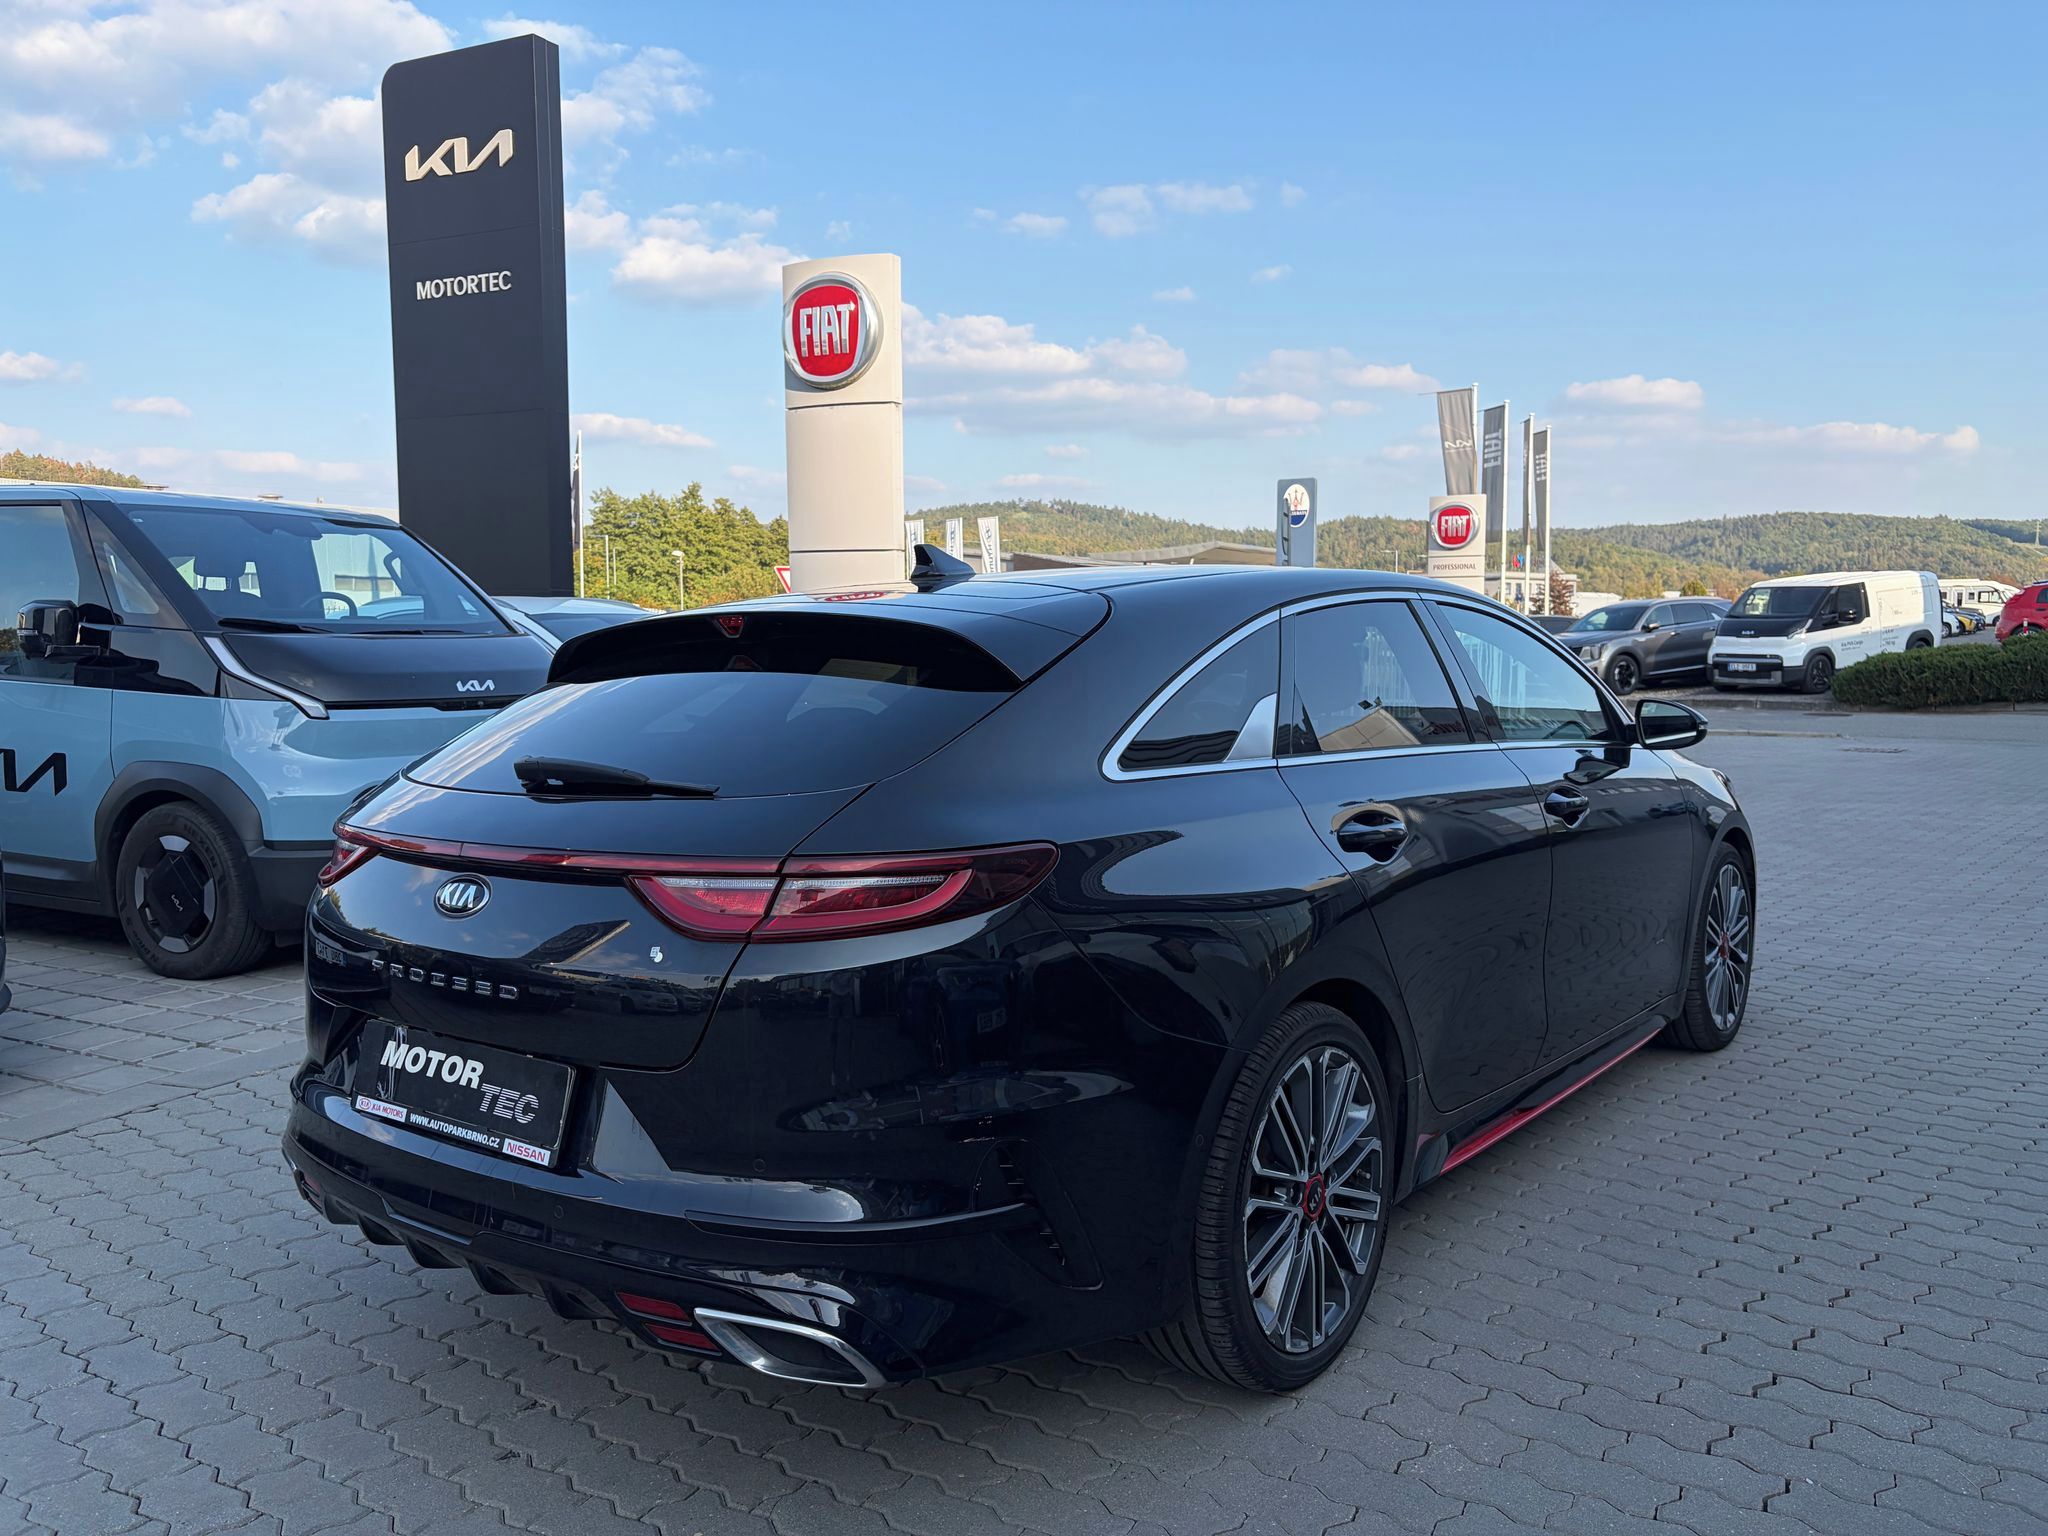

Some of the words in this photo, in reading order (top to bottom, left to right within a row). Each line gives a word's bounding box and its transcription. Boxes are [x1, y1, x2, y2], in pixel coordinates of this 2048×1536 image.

[405, 128, 513, 181] KIA
[416, 270, 512, 300] MOTORTEC
[801, 301, 855, 358] FIAT
[1441, 515, 1469, 537] FIAT
[1433, 563, 1476, 571] PROFESSIONAL
[456, 679, 495, 692] KIA
[438, 883, 477, 907] KIA
[371, 959, 519, 1000] PROCEED
[380, 1041, 485, 1089] MOTOR
[371, 1103, 381, 1112] KIA
[381, 1106, 404, 1118] MOTORS
[480, 1083, 540, 1124] TEC
[409, 1113, 500, 1149] WWW.AUTOPARKBRNO.CZ
[506, 1142, 546, 1163] NISSAN
